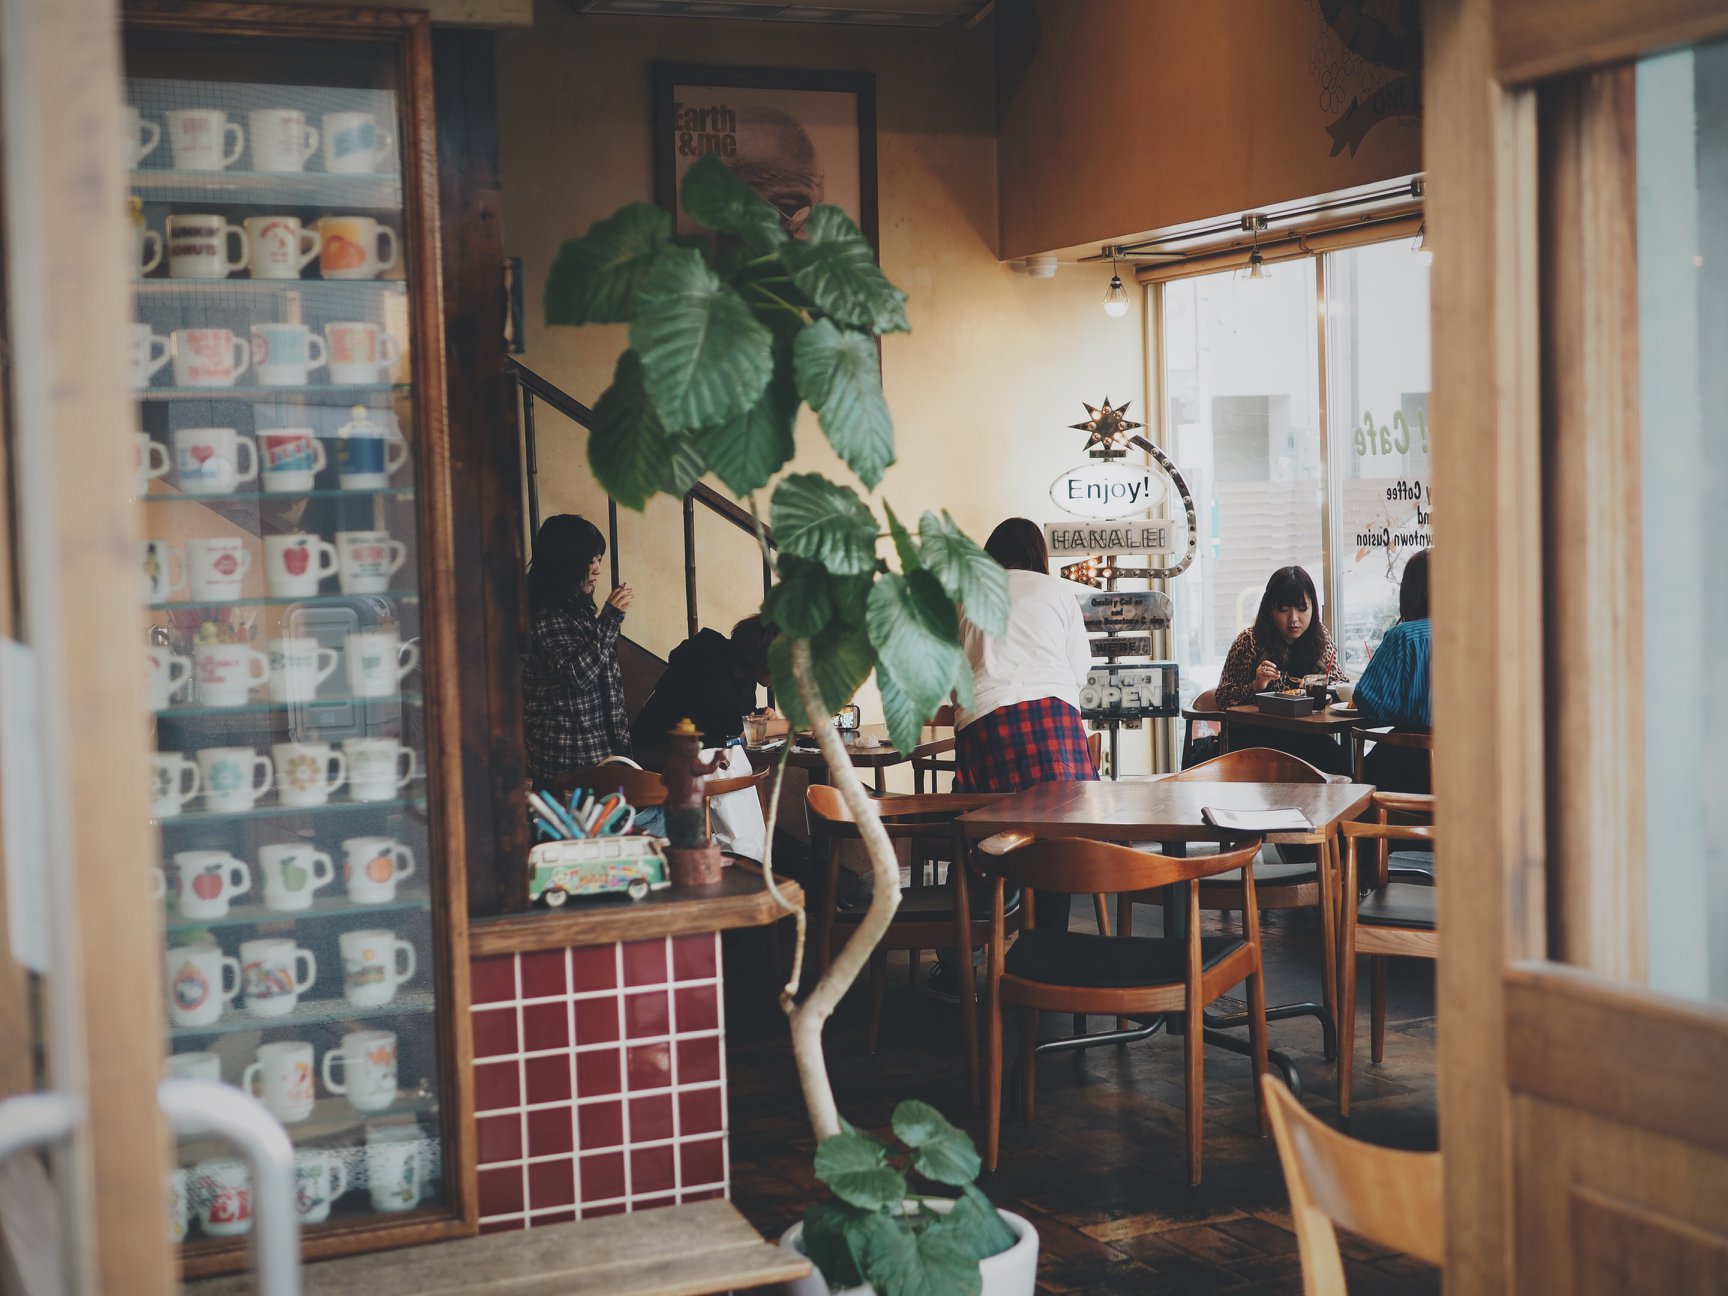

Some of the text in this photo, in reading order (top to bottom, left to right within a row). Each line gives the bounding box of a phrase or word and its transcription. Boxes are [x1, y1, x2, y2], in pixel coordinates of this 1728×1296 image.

[674, 102, 737, 133] Earth
[678, 131, 737, 158] & me
[1068, 476, 1149, 504] Enjoy!
[1052, 527, 1166, 550] HANALEI
[1079, 685, 1163, 710] OPEN
